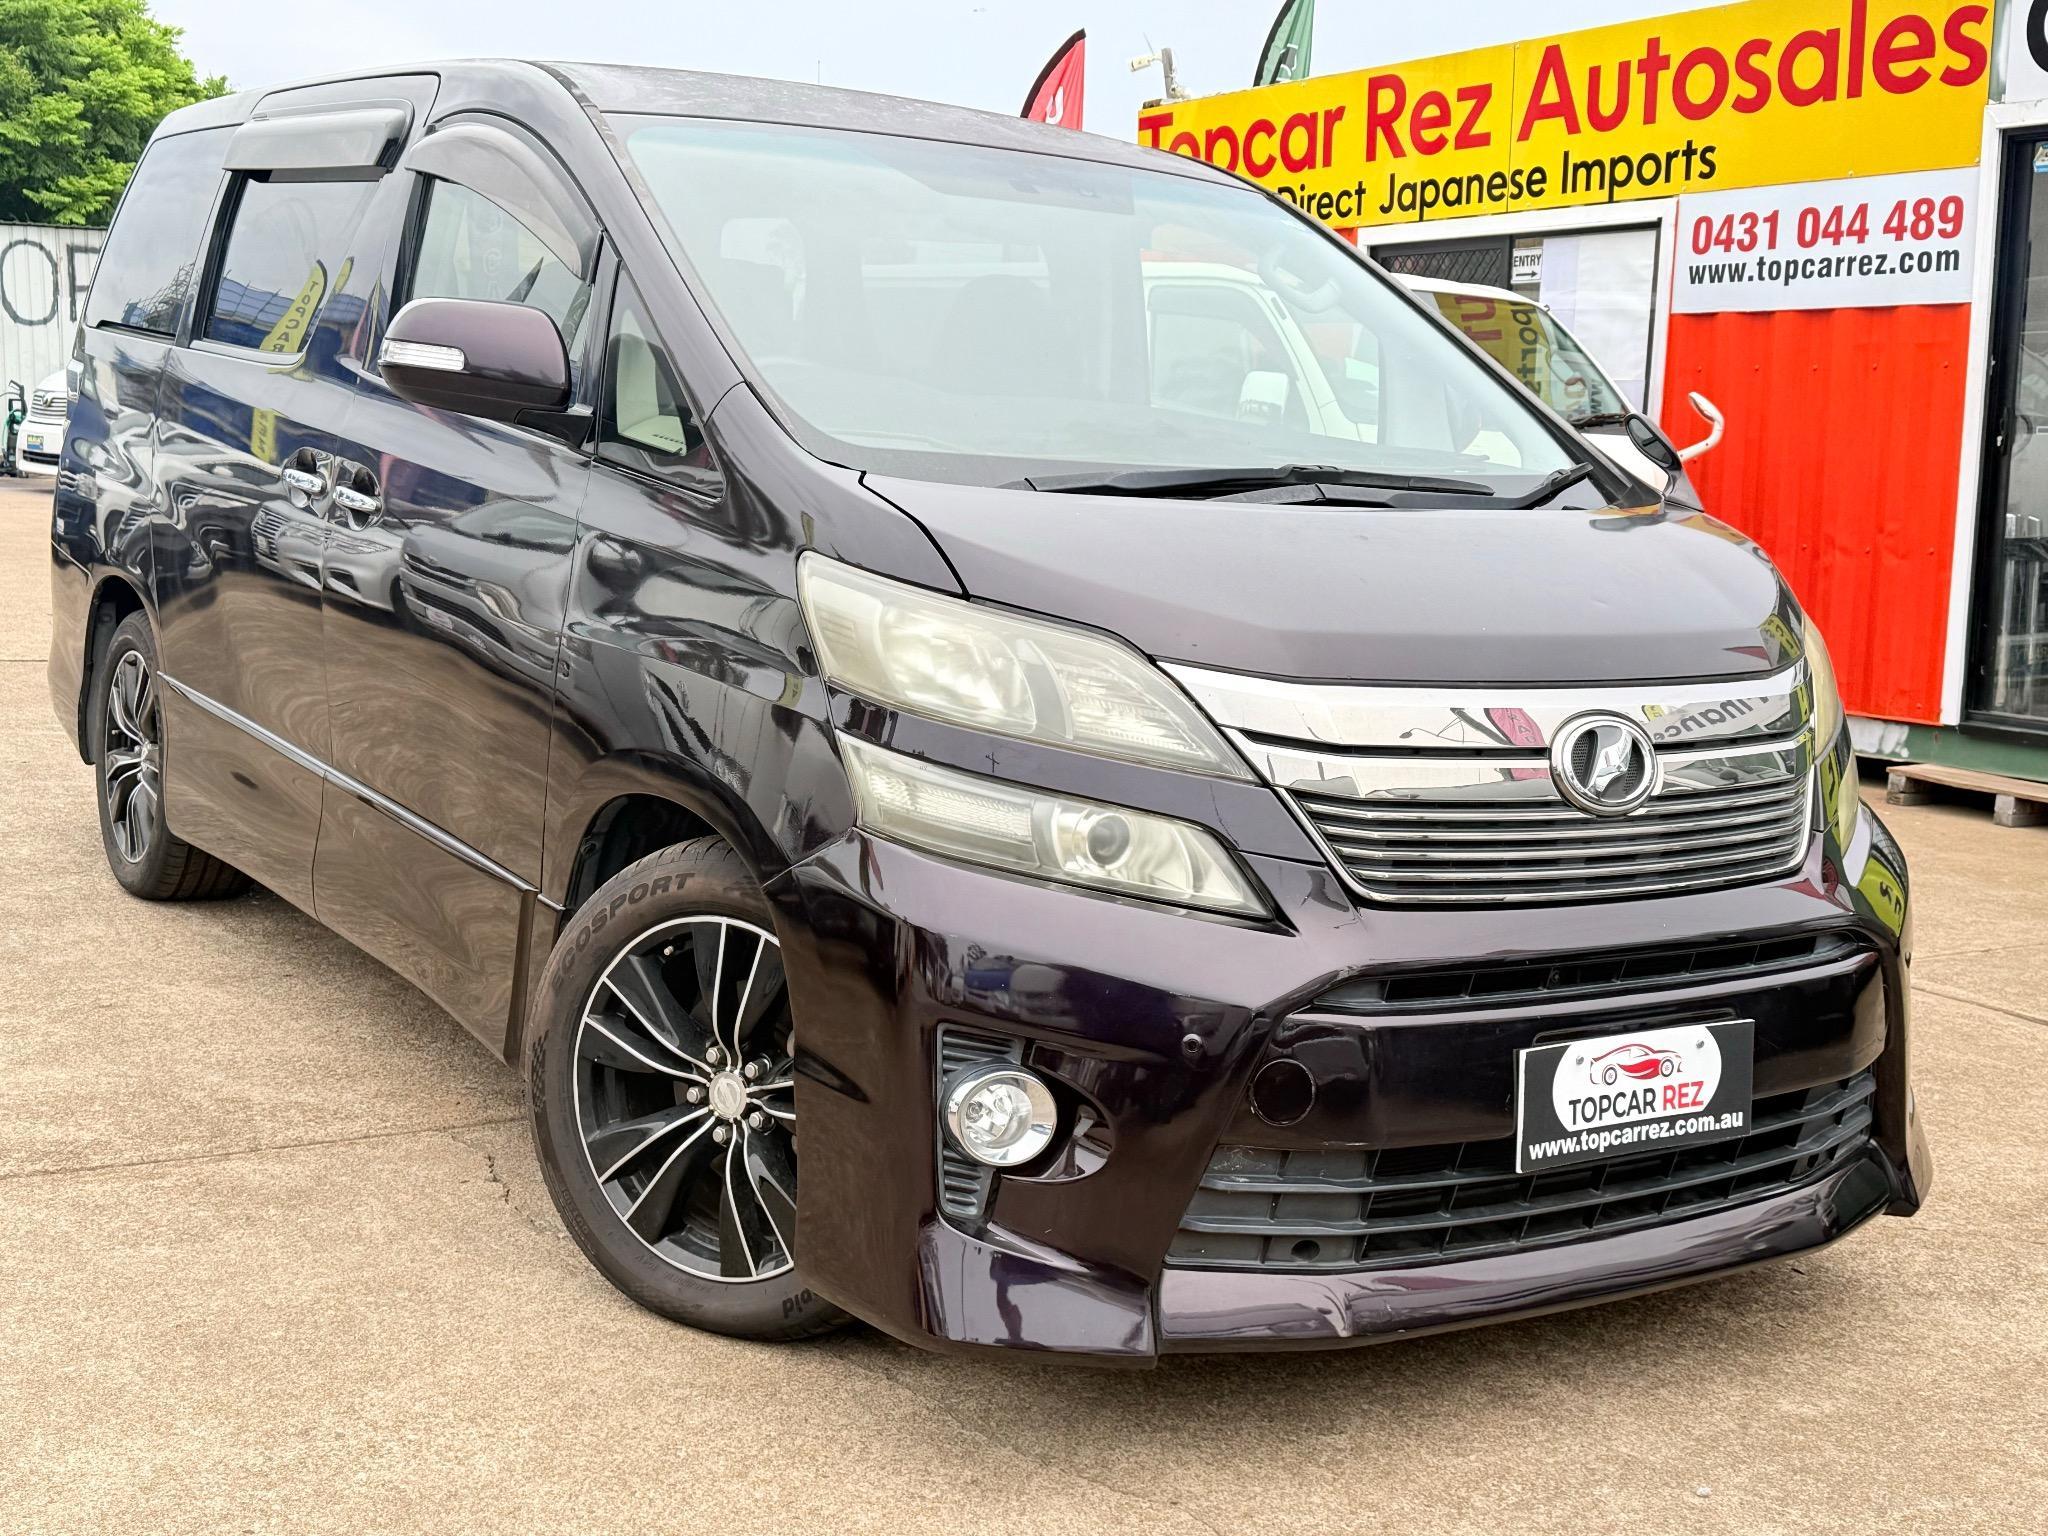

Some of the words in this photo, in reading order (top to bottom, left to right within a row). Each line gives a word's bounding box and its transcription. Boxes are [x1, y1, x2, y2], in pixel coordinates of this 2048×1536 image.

[1365, 73, 1493, 163] Rez
[1516, 0, 1989, 143] Autosales
[1378, 166, 1548, 222] Japanese
[1560, 140, 1717, 203] Imports
[1691, 209, 1780, 255] 0431
[1796, 203, 1870, 249] 044
[1882, 195, 1965, 241] 489
[1513, 253, 1542, 268] ENTRY
[1688, 249, 1961, 287] www.topcarrez.com
[1568, 1088, 1657, 1126] TOPCAR
[1662, 1080, 1704, 1111] REZ
[1528, 1111, 1744, 1160] www.topcarrez.com.au
